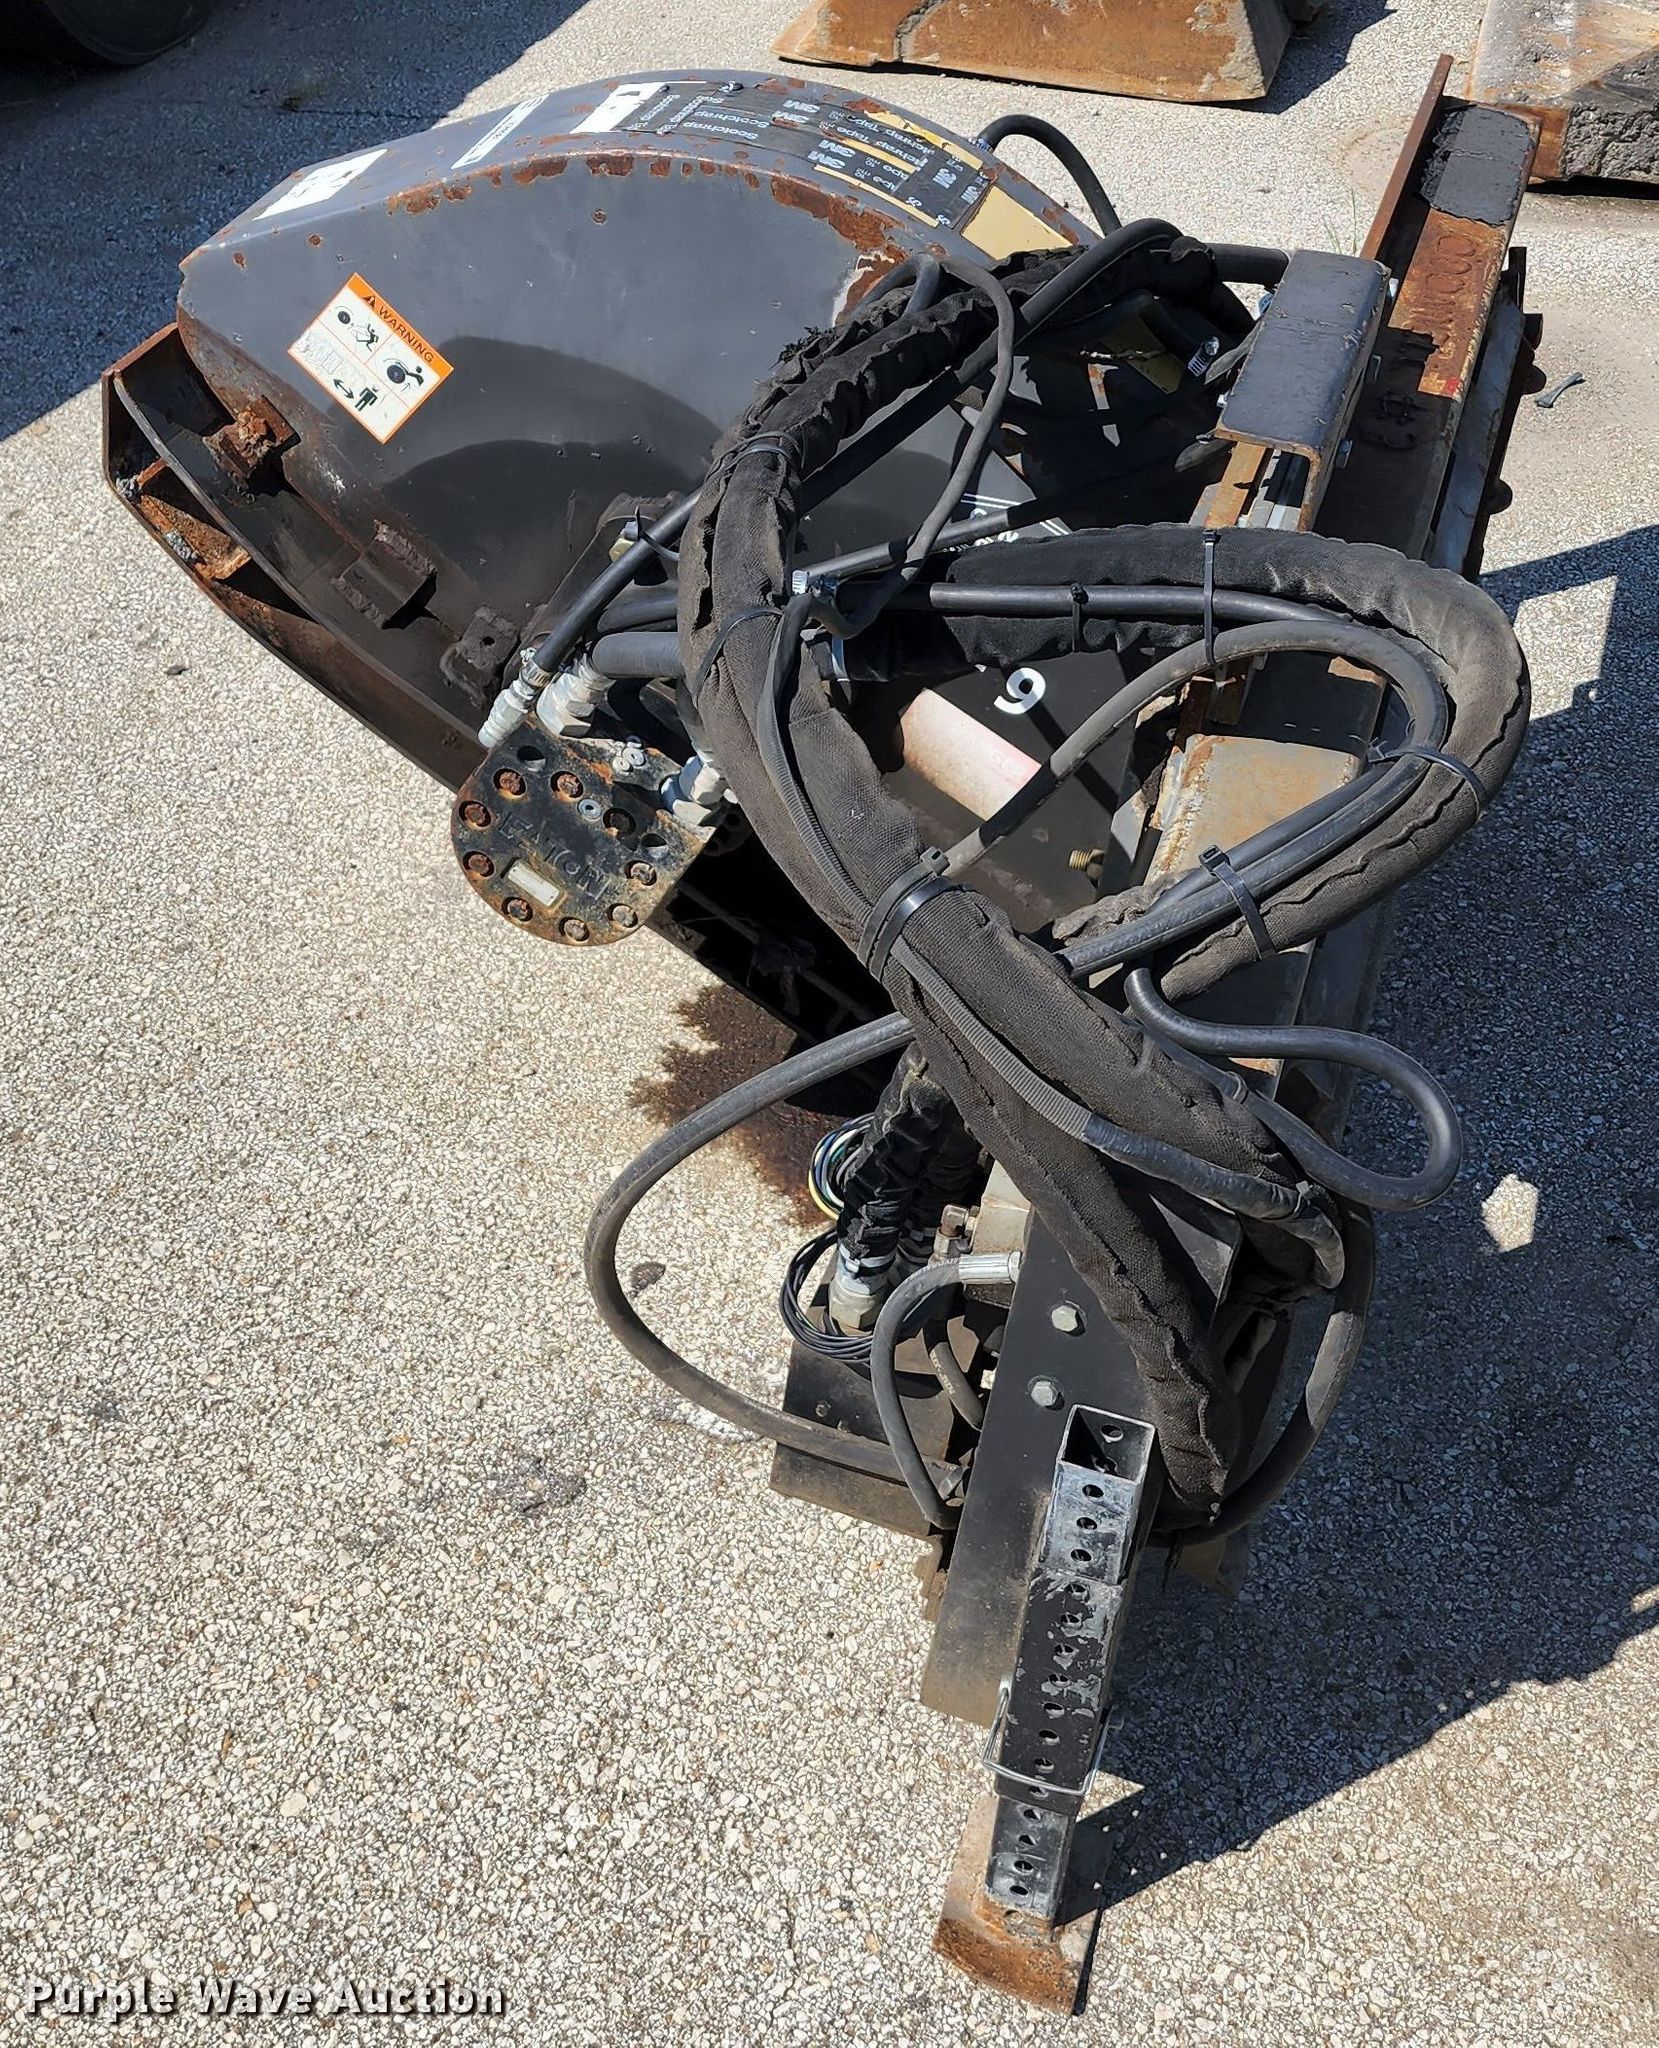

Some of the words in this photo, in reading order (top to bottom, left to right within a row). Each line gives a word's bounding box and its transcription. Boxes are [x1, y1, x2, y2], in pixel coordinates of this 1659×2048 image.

[783, 101, 820, 113] 3M
[694, 110, 770, 129] Scotchrap
[846, 115, 880, 133] Tap
[683, 121, 760, 140] Scotchrap
[837, 127, 870, 144] Tape
[818, 139, 856, 158] 3M
[807, 150, 846, 169] 3M
[932, 168, 957, 189] 3M
[379, 305, 434, 363] WARNING
[993, 667, 1047, 715] 9
[497, 810, 611, 901] EATON
